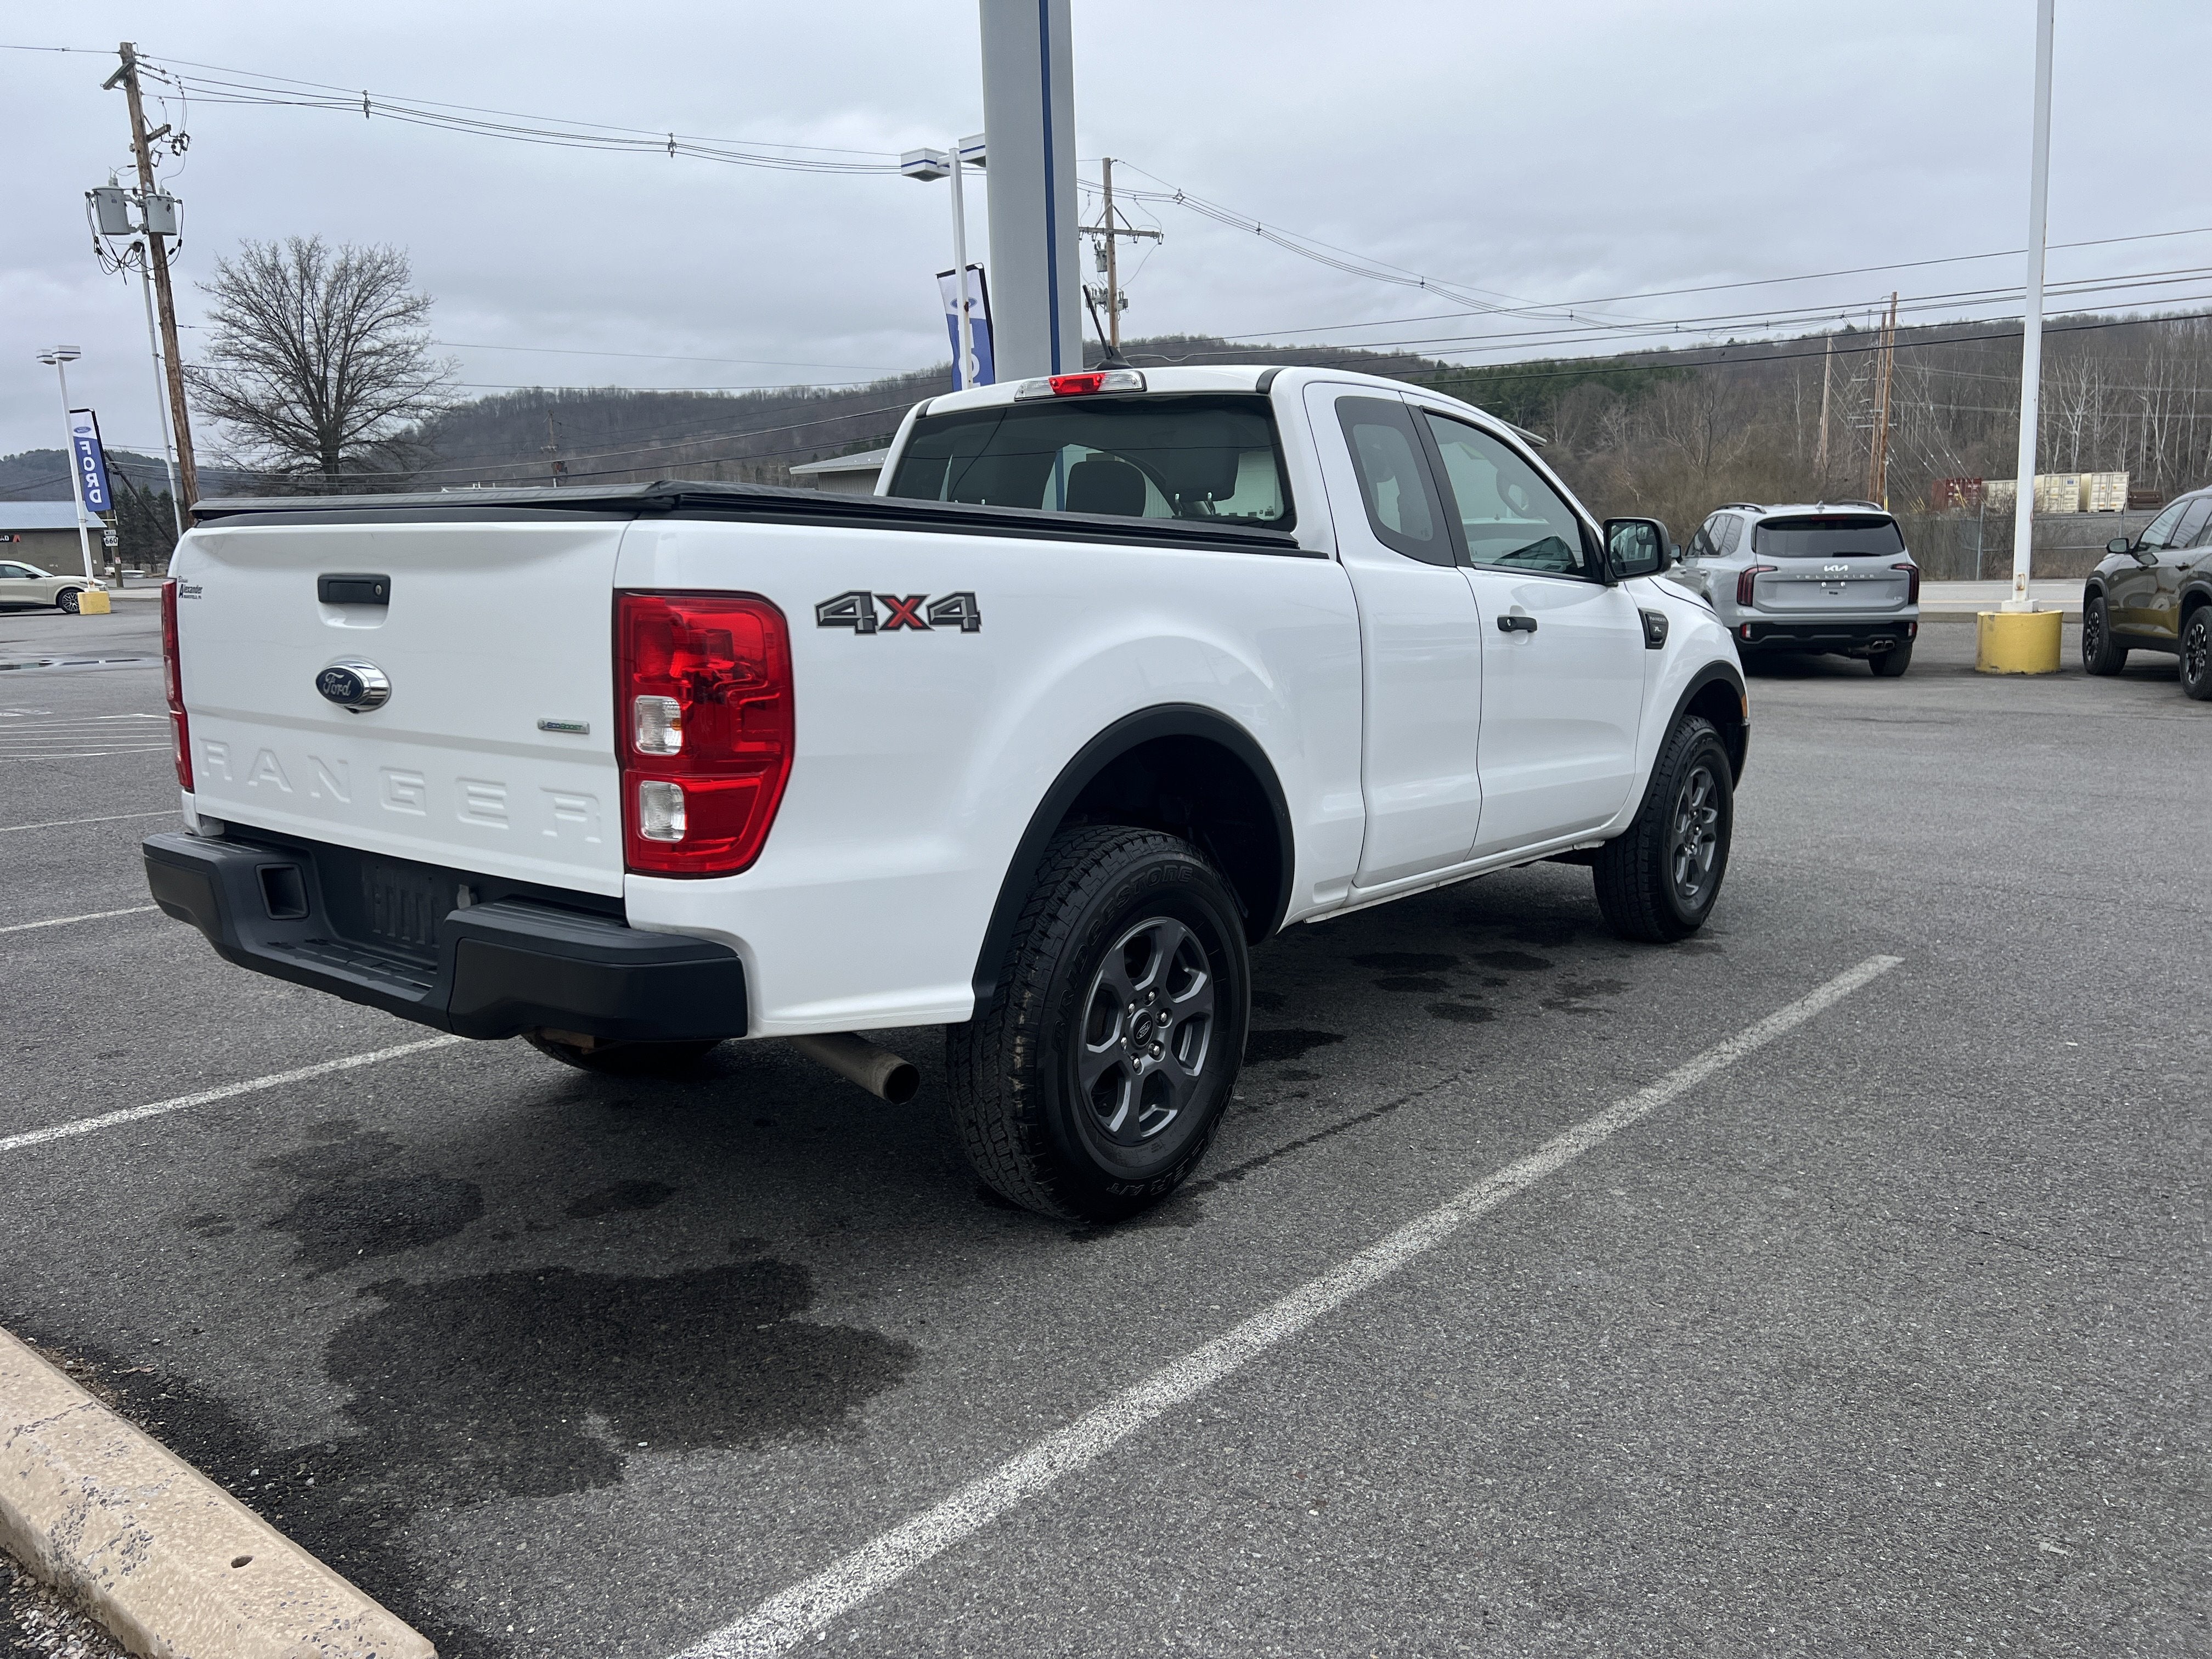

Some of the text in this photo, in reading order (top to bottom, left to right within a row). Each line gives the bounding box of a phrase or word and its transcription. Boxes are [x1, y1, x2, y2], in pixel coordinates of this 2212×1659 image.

[179, 584, 203, 598] Alexander
[322, 672, 352, 697] Ford
[199, 738, 603, 844] RANGER
[1051, 864, 1193, 1055] BRIDGESTONE
